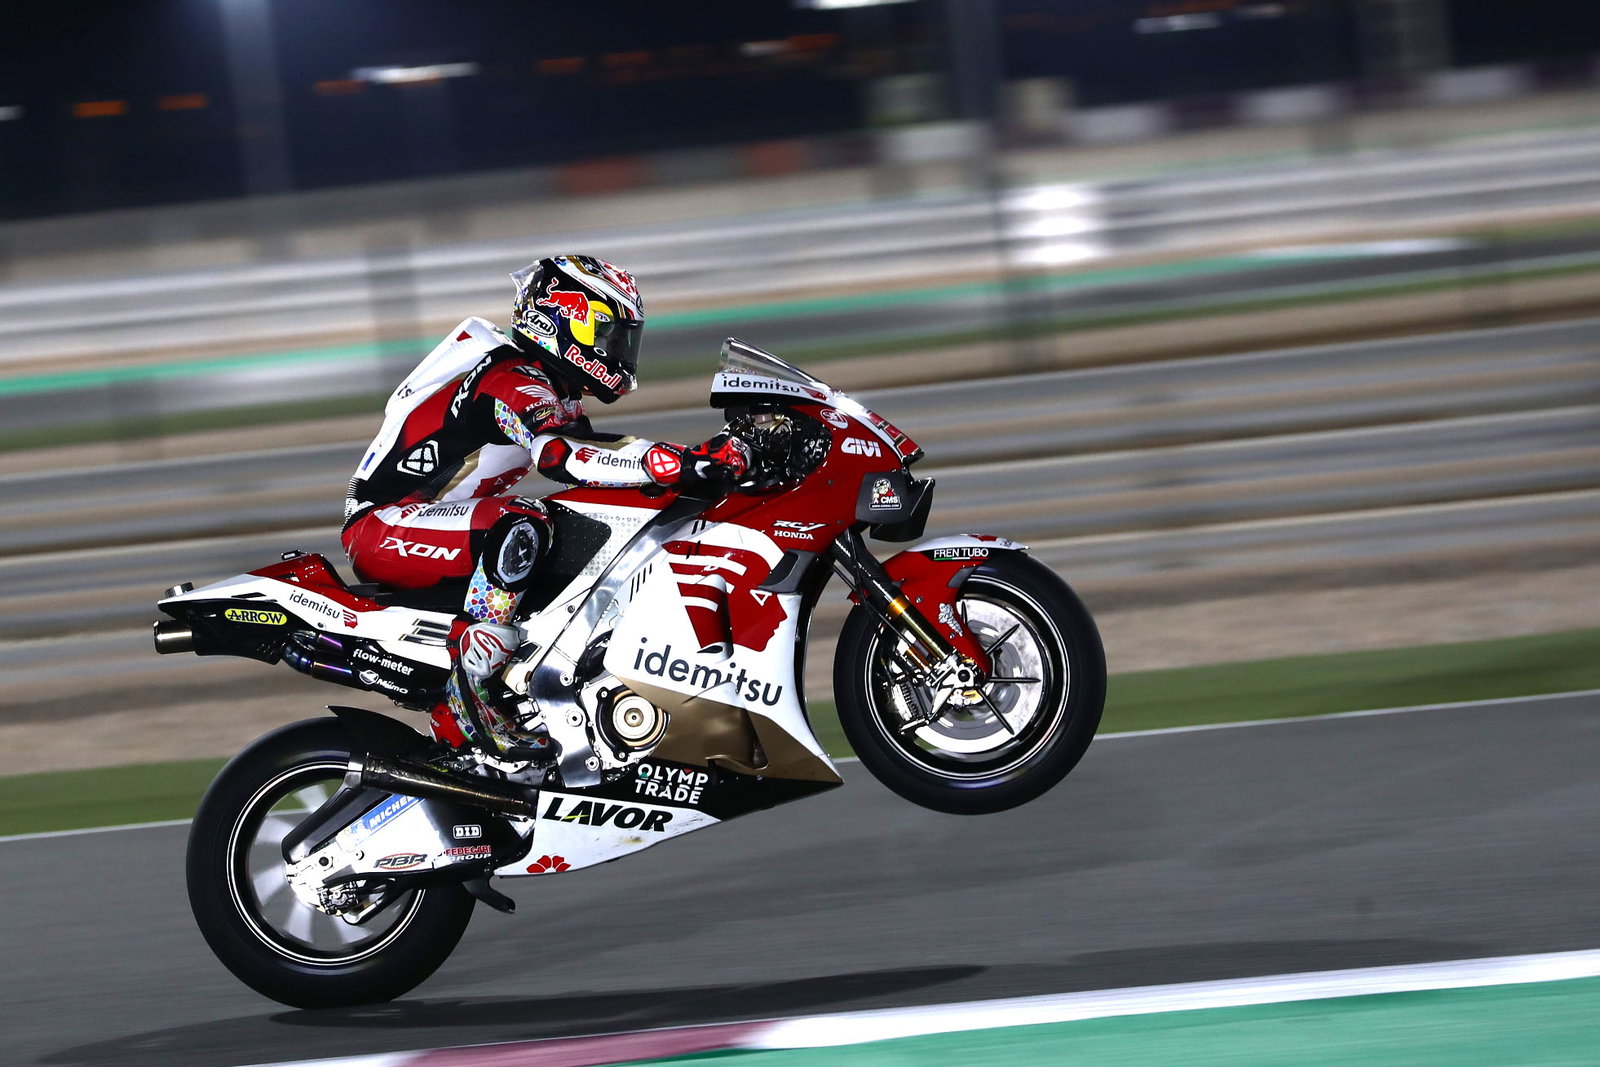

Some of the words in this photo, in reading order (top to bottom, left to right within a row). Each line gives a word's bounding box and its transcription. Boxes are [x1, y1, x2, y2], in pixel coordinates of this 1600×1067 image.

[564, 344, 599, 374] Red
[592, 360, 623, 390] Bull
[723, 376, 800, 393] idemitsu
[840, 437, 882, 458] GIVI
[597, 453, 642, 470] idemit
[880, 496, 899, 504] CMS
[773, 530, 814, 540] HONDA
[934, 548, 960, 558] FREN
[962, 548, 989, 558] TUBO
[227, 609, 284, 624] ARROW
[289, 590, 340, 620] idemitsu
[352, 648, 414, 676] flow-meter
[634, 637, 783, 706] idemitsu
[637, 763, 709, 787] OLYMP
[635, 779, 704, 805] TRADE
[368, 795, 416, 828] MICHE
[542, 797, 673, 832] LAVOR
